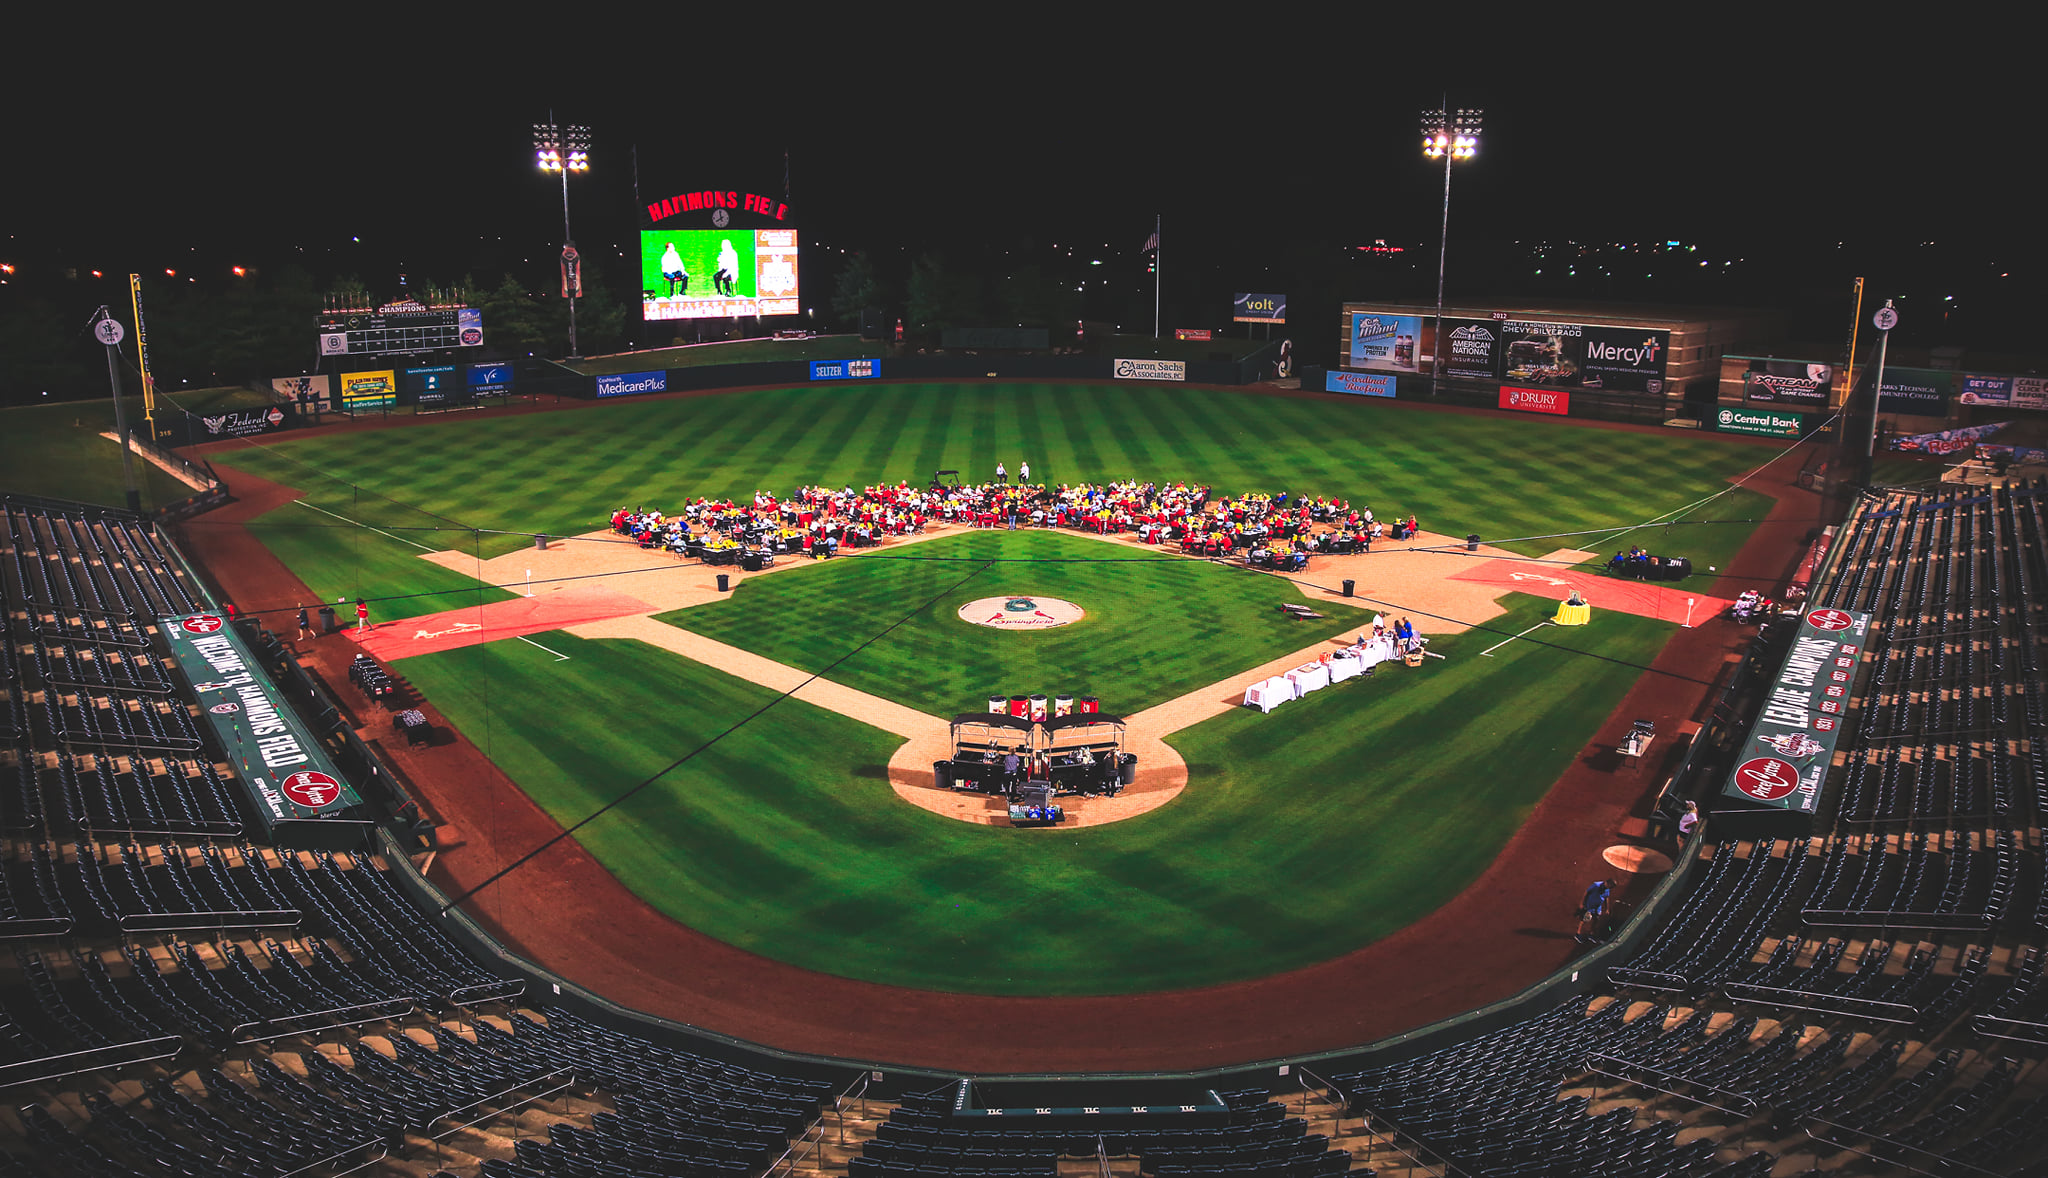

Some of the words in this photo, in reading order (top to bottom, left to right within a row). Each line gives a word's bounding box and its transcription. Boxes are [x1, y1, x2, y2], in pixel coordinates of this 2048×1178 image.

[648, 191, 738, 222] HAMMONS
[379, 305, 426, 313] CHAMPIONS
[1246, 298, 1274, 310] volt
[1359, 319, 1399, 338] Hiland
[1502, 326, 1530, 334] CHEVY
[1533, 327, 1582, 337] SILVERADO
[1452, 340, 1491, 349] AMERICAN
[1452, 347, 1489, 356] NATIONAL
[1588, 341, 1645, 366] Mercy
[816, 366, 842, 377] SELTZER
[1129, 361, 1156, 371] Aaron
[1158, 362, 1183, 371] Sachs
[1345, 374, 1388, 385] Cardinal
[1754, 375, 1819, 394] XTREAM
[1344, 383, 1385, 394] Roofing
[1899, 385, 1937, 393] TECHNICAL
[1909, 392, 1940, 400] COLLEGE
[1520, 392, 1557, 405] DRURY
[1520, 402, 1556, 410] UNIVERSITY
[227, 409, 268, 428] Federal
[1734, 414, 1770, 426] Central
[1772, 417, 1800, 428] Bank
[190, 634, 247, 674] WELCOME
[1780, 636, 1839, 687] CHAMPIONS
[224, 671, 254, 688] TO
[236, 684, 287, 736] HAMMONS
[1762, 687, 1812, 729] LEAGUE
[256, 734, 309, 768] FIELD
[1752, 780, 1774, 798] Price
[1797, 777, 1819, 796] LOCAL
[265, 789, 284, 805] LOCAL
